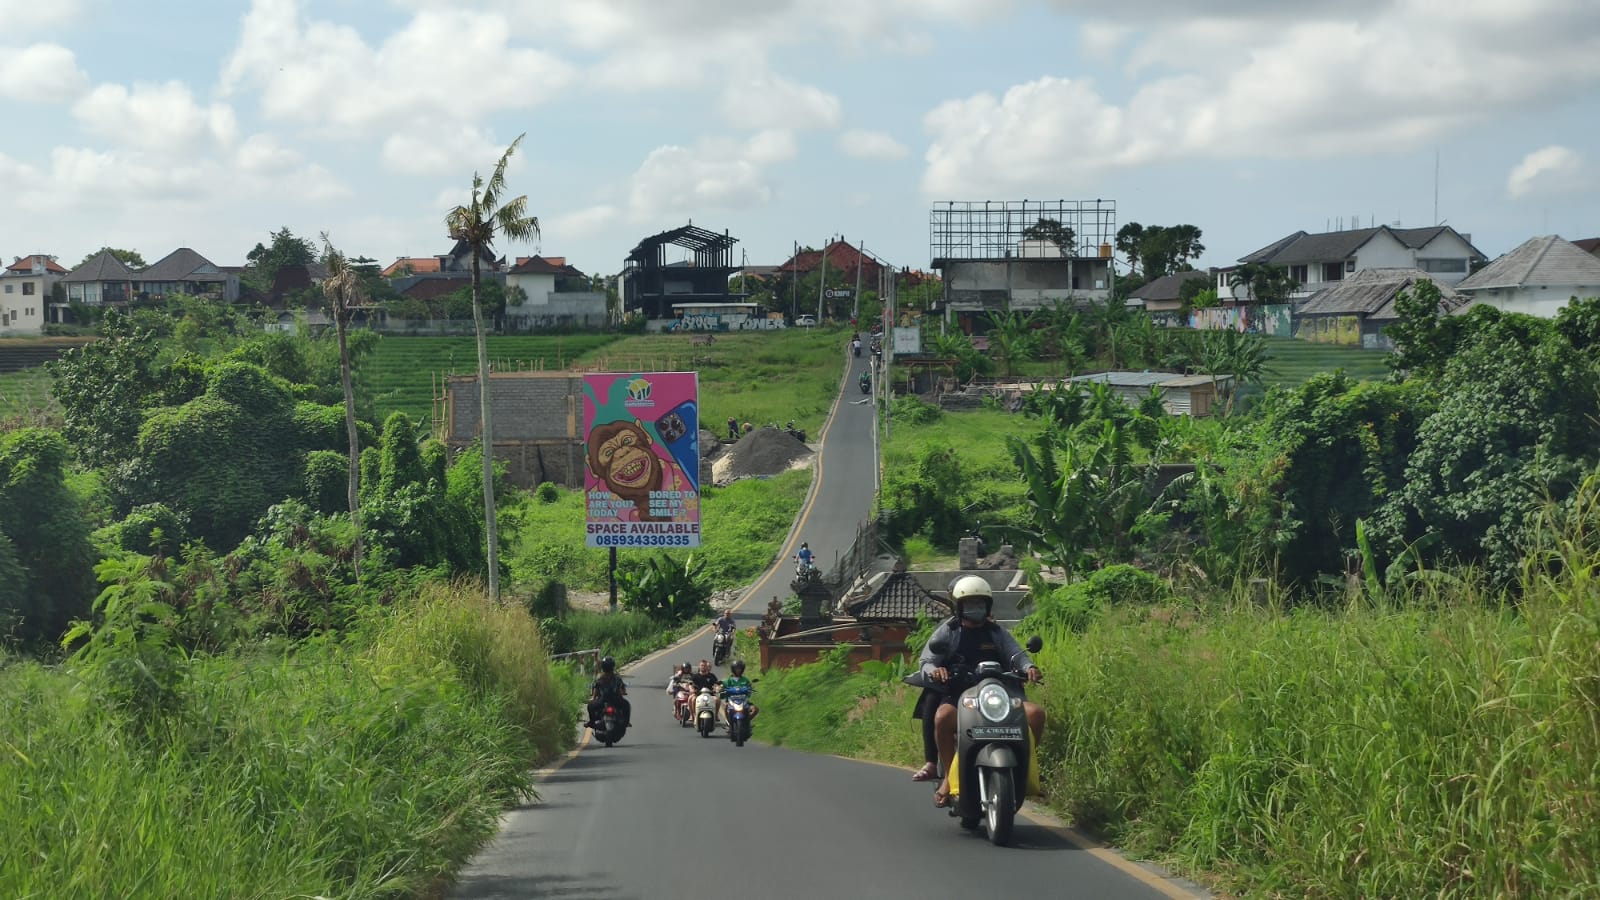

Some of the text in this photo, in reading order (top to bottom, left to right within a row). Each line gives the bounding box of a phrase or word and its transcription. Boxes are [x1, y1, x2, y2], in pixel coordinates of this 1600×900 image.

[588, 491, 611, 500] HOW
[649, 491, 681, 499] BORED
[588, 500, 635, 508] ARE YOU?
[649, 500, 683, 508] SEE MY
[589, 509, 618, 517] TODAY
[649, 508, 679, 517] SMILE
[587, 524, 699, 534] SPACE AVAILABLE
[596, 535, 690, 546] 085934330335
